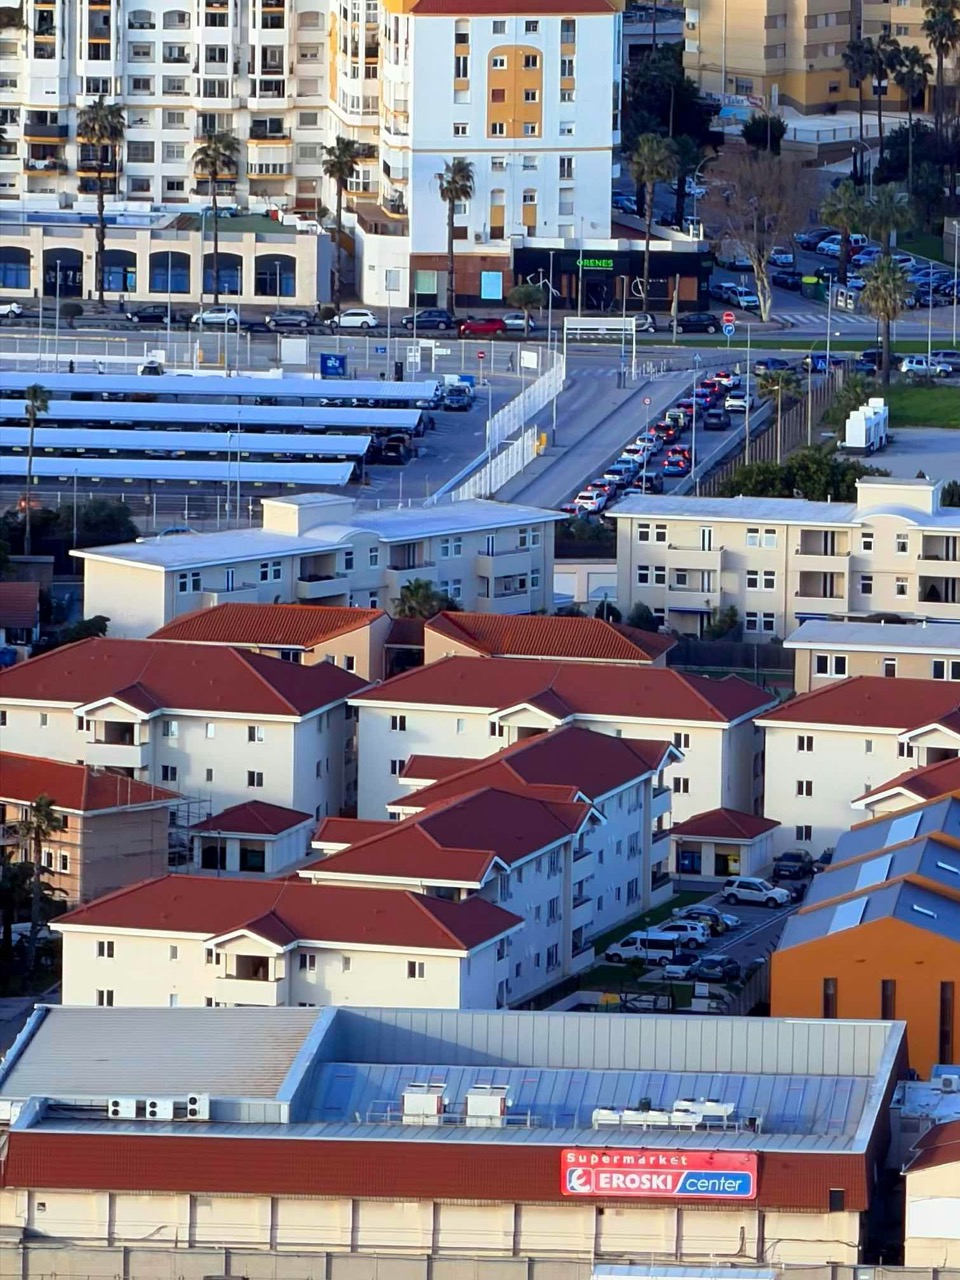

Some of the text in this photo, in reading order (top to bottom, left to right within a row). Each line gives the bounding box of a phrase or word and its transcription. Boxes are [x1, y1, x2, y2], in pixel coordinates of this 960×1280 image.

[576, 259, 614, 267] ORENES
[566, 1152, 688, 1166] Supermarket
[599, 1173, 743, 1192] EROSKI center
